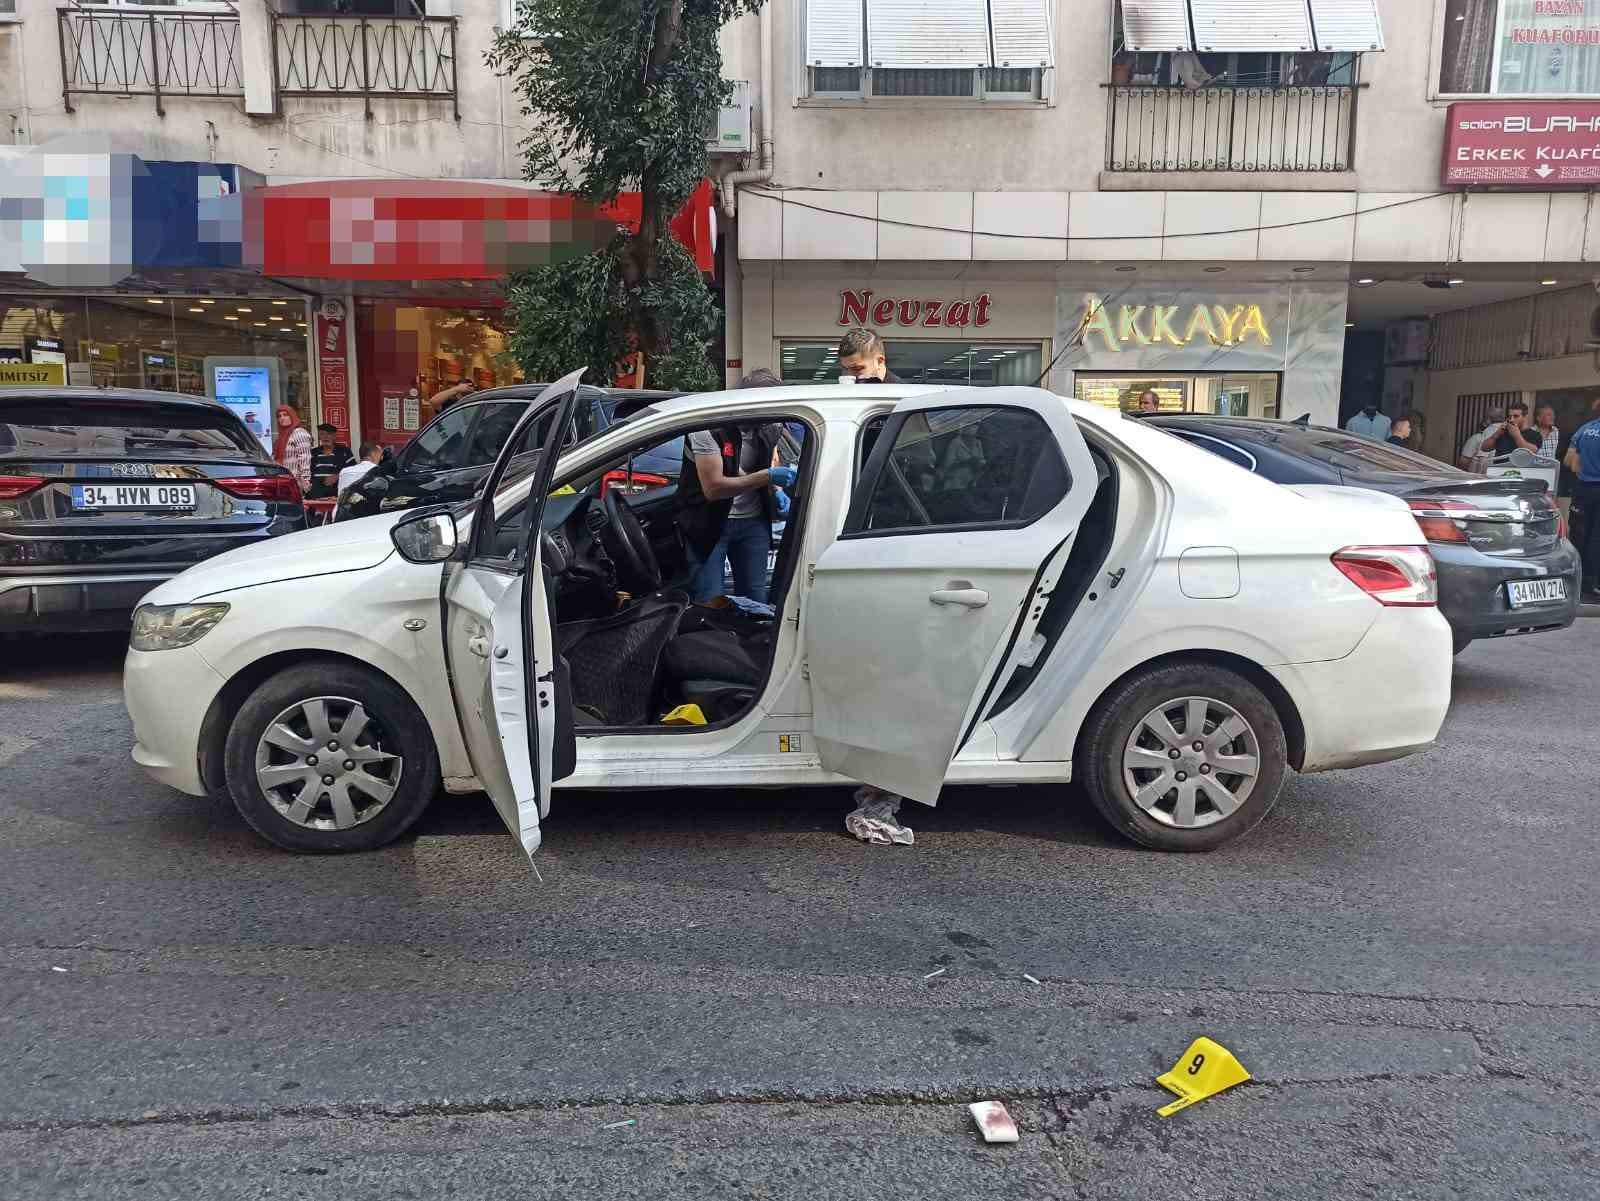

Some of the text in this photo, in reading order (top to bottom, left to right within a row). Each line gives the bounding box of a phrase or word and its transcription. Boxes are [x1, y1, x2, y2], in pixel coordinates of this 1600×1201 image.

[1535, 0, 1583, 14] BAYAN
[1459, 120, 1502, 129] salon
[1457, 147, 1527, 160] ERKEK
[838, 289, 992, 327] Nevzat
[1071, 293, 1272, 352] AKKAYA
[85, 488, 191, 504] 34 HVN 089
[1514, 583, 1528, 601] 34
[1528, 581, 1547, 600] HAV
[1188, 1054, 1205, 1075] 9
